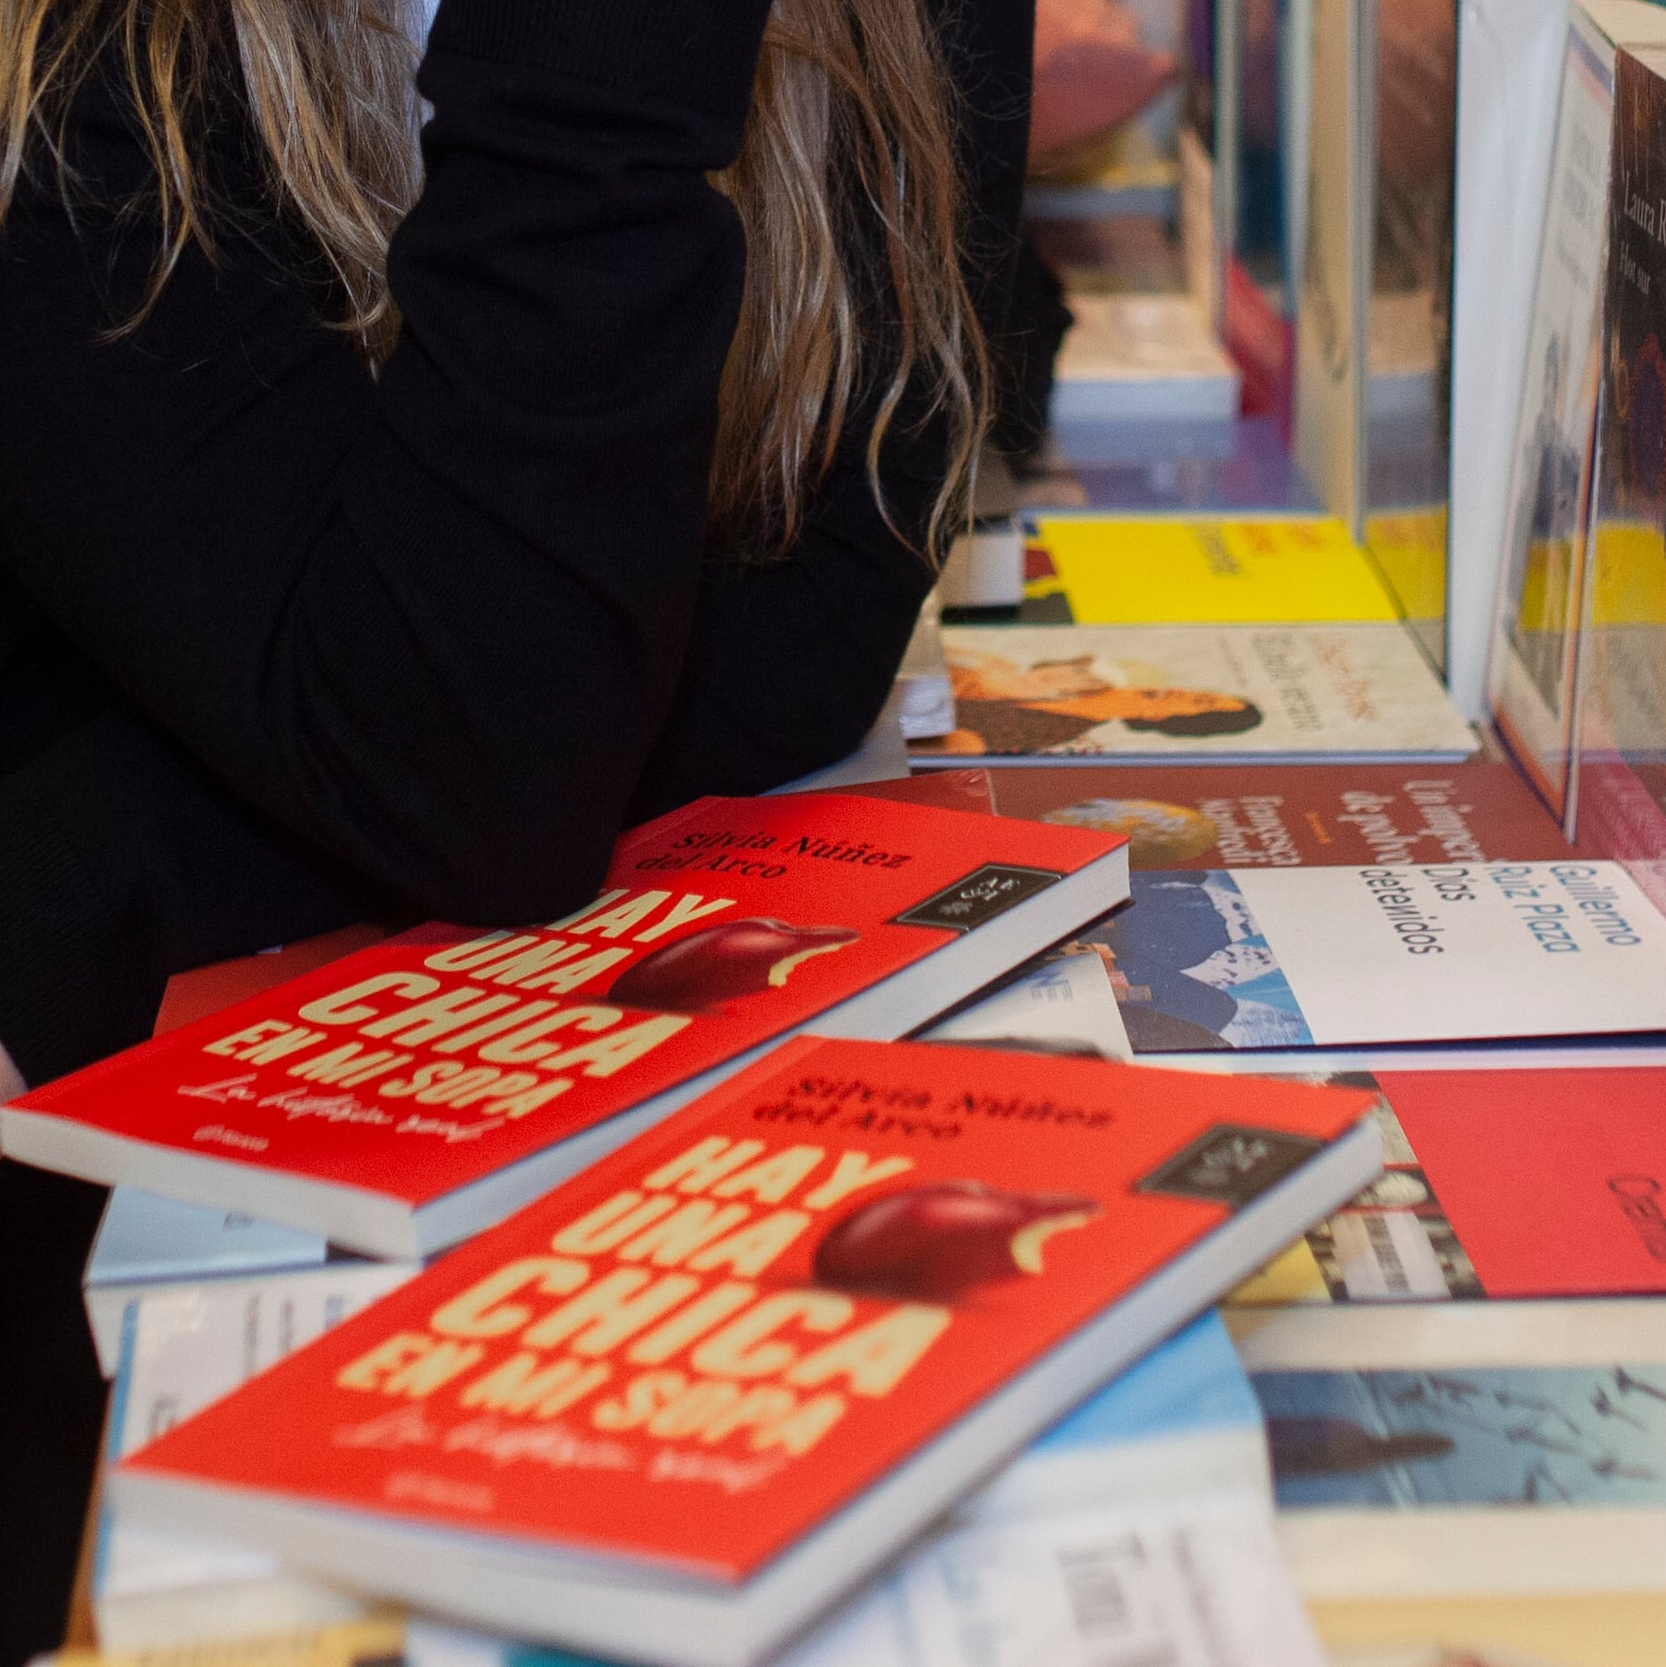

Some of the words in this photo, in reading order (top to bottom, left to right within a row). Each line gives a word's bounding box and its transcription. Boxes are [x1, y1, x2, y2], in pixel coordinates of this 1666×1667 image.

[1623, 169, 1655, 236] Laura
[634, 852, 694, 872] del
[690, 856, 788, 881] Arco
[671, 829, 776, 853] Silvia
[784, 835, 913, 871] Núñez
[1483, 865, 1548, 900] Ruiz
[1359, 868, 1445, 956] detenidos
[1513, 903, 1581, 954] Plaza
[1549, 864, 1642, 947] Guillermo
[423, 929, 635, 996] UNA
[297, 971, 696, 1079] CHICA
[201, 1019, 328, 1067] EN
[286, 1041, 416, 1089] MI
[377, 1060, 576, 1120] SOPA
[944, 1087, 1116, 1130] Núñez
[641, 1136, 916, 1210] HAY
[549, 1190, 813, 1278] UNA
[428, 1256, 954, 1400] CHICA
[335, 1332, 485, 1398] EN
[459, 1351, 613, 1419] MI
[590, 1370, 848, 1457] SOPA
